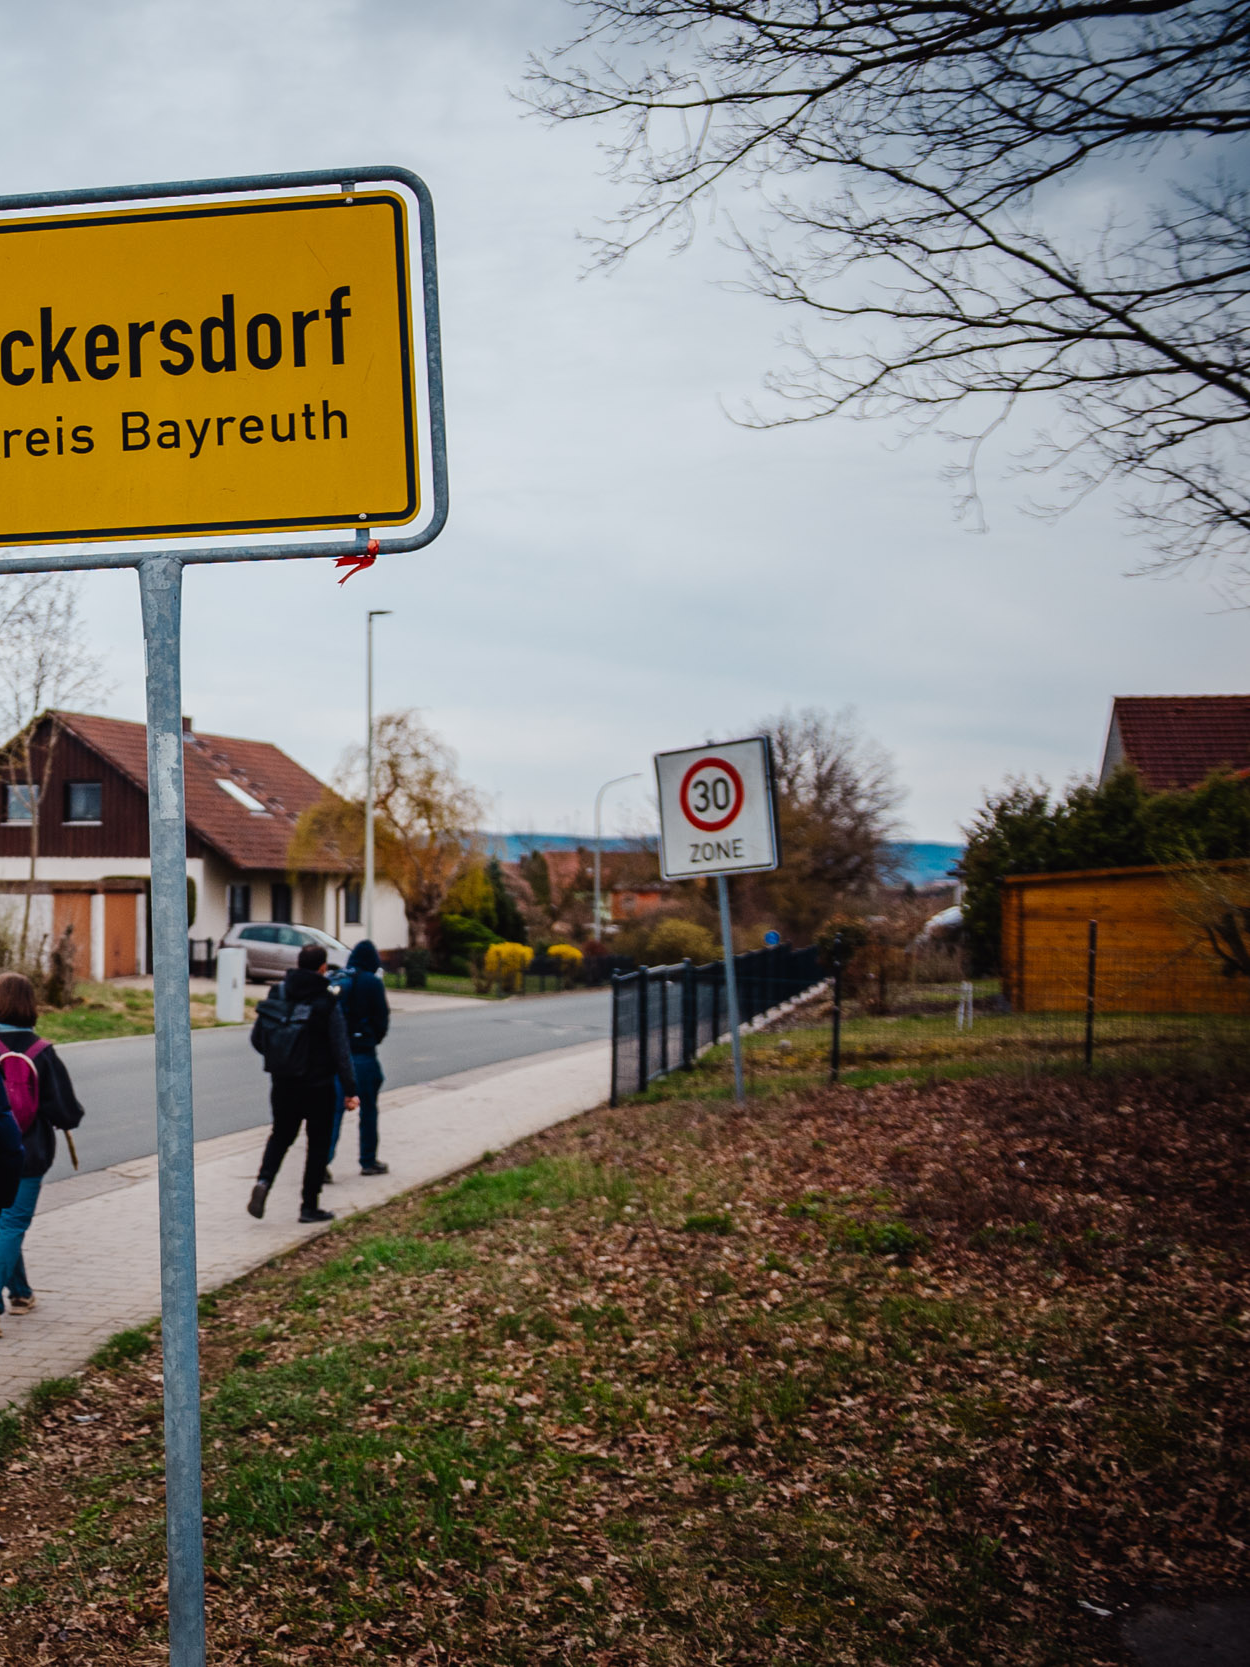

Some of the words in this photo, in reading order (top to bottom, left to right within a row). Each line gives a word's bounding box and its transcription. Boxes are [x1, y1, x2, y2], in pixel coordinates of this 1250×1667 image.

[121, 399, 348, 459] Bayreuth
[692, 777, 731, 813] 30
[689, 838, 745, 864] ZONE
